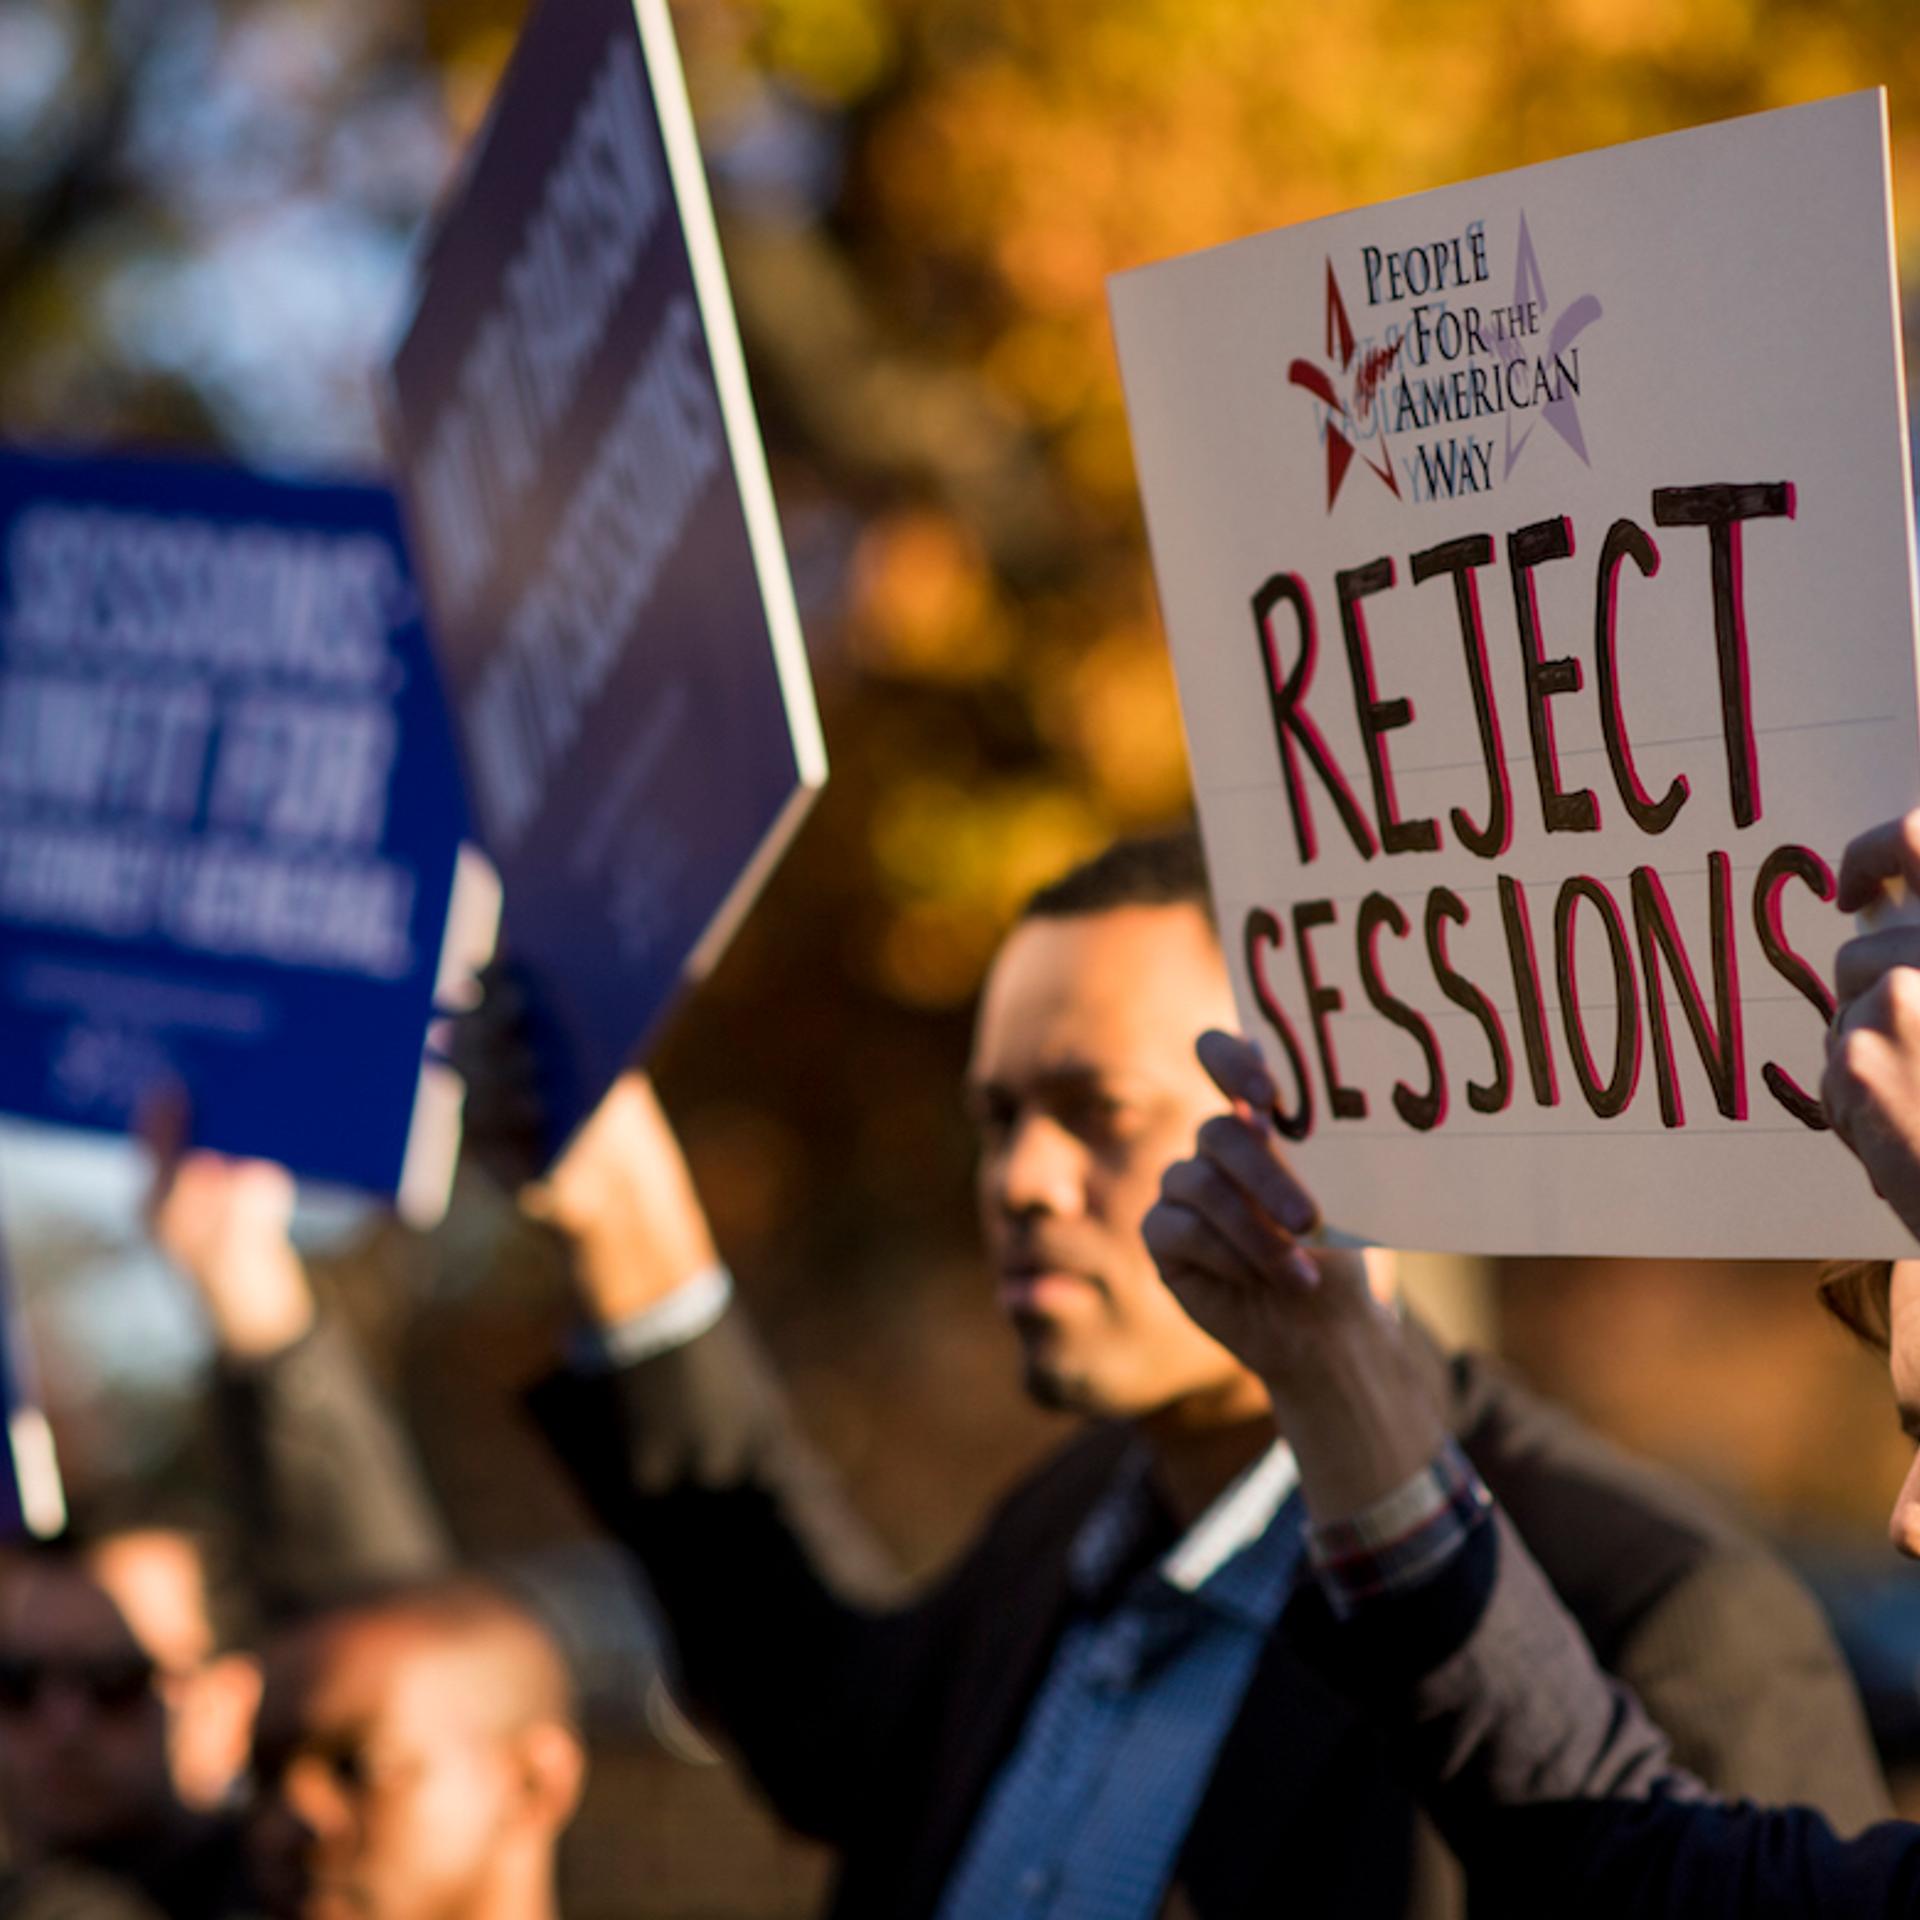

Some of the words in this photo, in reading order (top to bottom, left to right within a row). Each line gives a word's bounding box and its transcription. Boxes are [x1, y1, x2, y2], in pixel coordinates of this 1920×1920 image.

[1361, 232, 1489, 306] PEOPLE
[1411, 305, 1490, 366] FOR
[1491, 302, 1540, 342] THE
[1395, 349, 1581, 433] AMERICAN
[1417, 439, 1494, 500] WAY
[1251, 481, 1797, 865] REJECT
[1243, 844, 1838, 1142] SESSIONS
